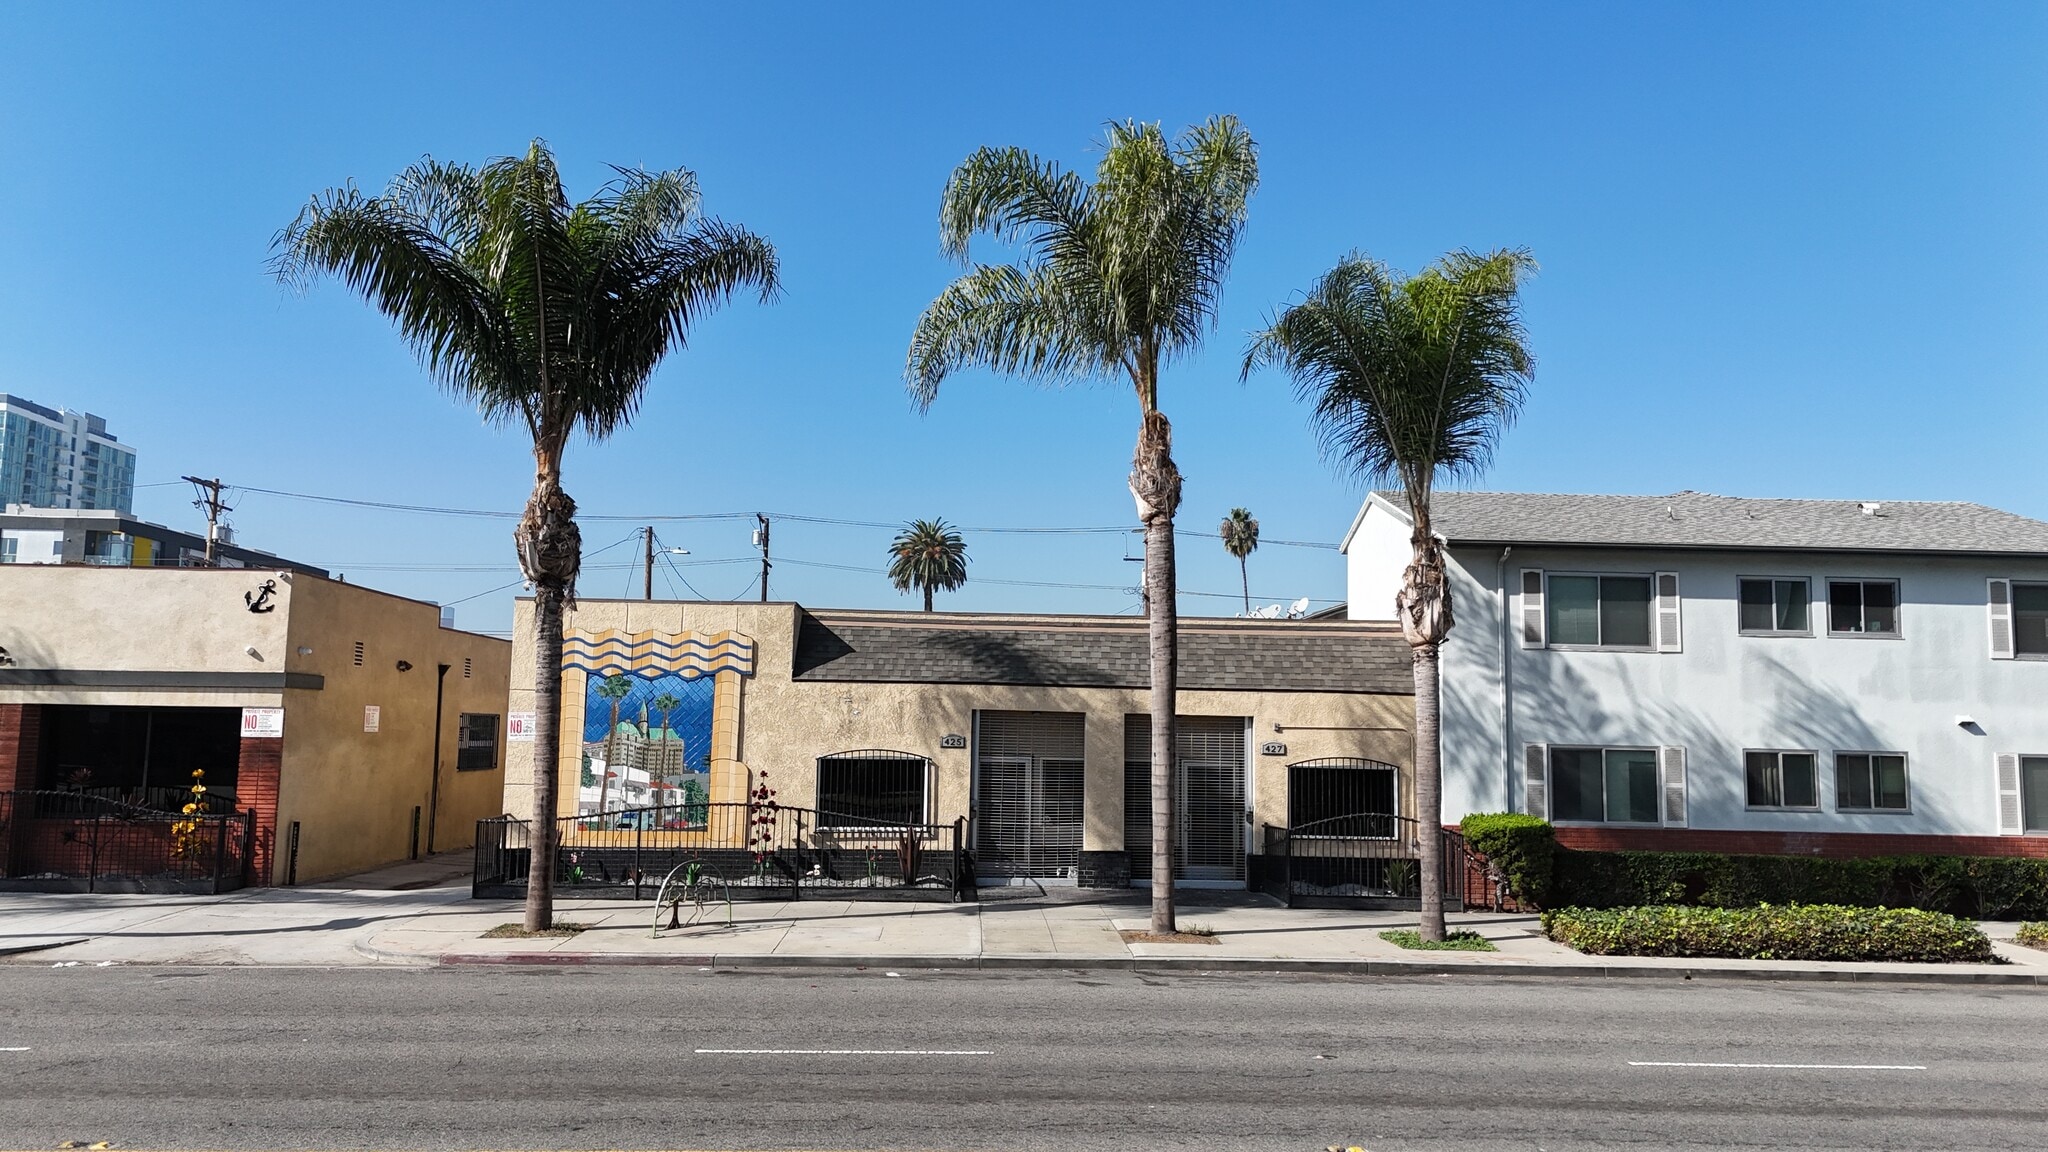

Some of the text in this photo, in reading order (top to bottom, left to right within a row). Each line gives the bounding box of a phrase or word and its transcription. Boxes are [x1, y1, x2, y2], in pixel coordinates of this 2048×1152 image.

[244, 714, 258, 729] NO
[510, 719, 523, 733] NO
[944, 738, 962, 746] 425
[1265, 745, 1283, 753] 427
